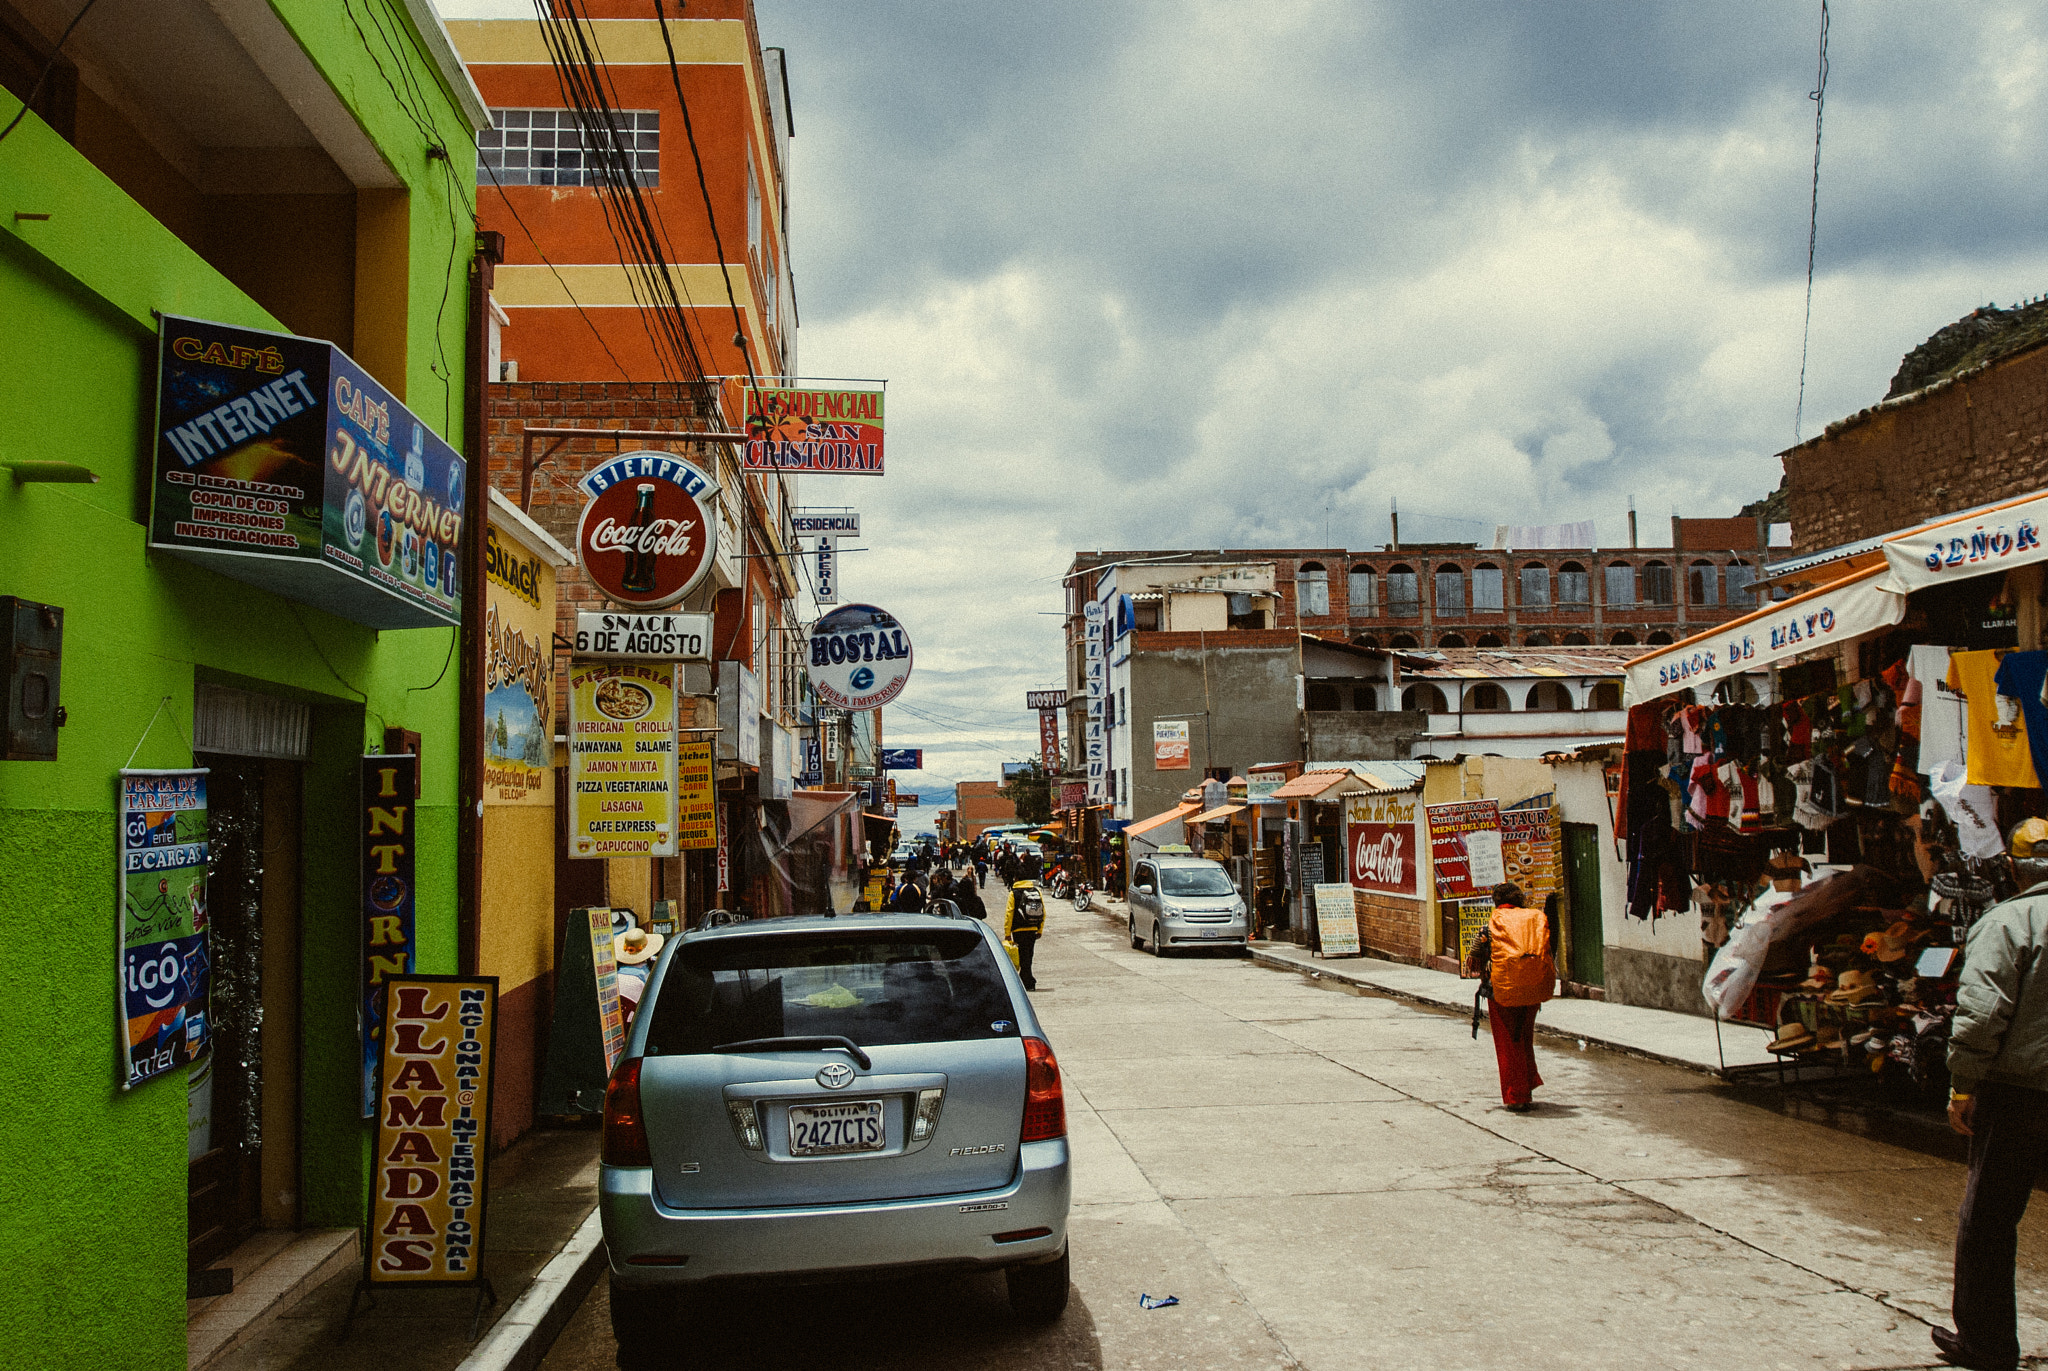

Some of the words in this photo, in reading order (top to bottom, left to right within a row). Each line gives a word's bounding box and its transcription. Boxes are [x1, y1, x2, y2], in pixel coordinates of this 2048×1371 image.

[173, 337, 284, 375] CAFÉ
[335, 376, 390, 445] CAFÉ
[746, 390, 883, 420] RESIDENCIAL
[165, 370, 317, 466] INTERNET
[806, 424, 862, 440] SAN
[745, 440, 884, 471] CRISTOBAL
[166, 471, 195, 486] SE
[198, 474, 304, 499] REALIZAN:
[594, 458, 702, 495] SIEMPRE
[190, 490, 235, 508] COPIA
[235, 494, 255, 511] DE
[192, 507, 285, 531] IMPRESIONES
[793, 517, 858, 530] RESIDENCIAL
[175, 522, 299, 550] INVESTIGACIONES.
[486, 525, 541, 606] SNACK
[818, 537, 832, 595] IMPERIO
[602, 615, 678, 632] SNACK
[1729, 635, 1755, 664] DE
[1770, 607, 1836, 651] MAYO
[576, 631, 589, 651] 6
[594, 632, 620, 652] DE
[625, 632, 701, 655] AGOSTO
[809, 630, 909, 666] HOSTAL
[572, 666, 672, 690] PIZZERIA
[1088, 624, 1104, 714] PLAYA
[818, 680, 849, 706] VILLA
[852, 675, 905, 706] IMPERIAL
[1028, 692, 1066, 707] HOSTAL
[634, 721, 673, 733] CRIOLLA
[573, 741, 623, 753] HAWAYANA
[635, 741, 672, 752] SALAME
[586, 761, 618, 773] JAMON
[620, 761, 627, 772] Y
[629, 761, 658, 772] MIXTA
[1088, 724, 1105, 796] AZUL
[126, 777, 175, 792] VENTA
[178, 777, 197, 791] DE
[576, 781, 603, 793] PIZZA
[605, 781, 669, 792] VEGETARIANA
[126, 793, 197, 809] TARJETAS
[601, 801, 644, 812] LASAGNA
[1429, 803, 1495, 814] RESTAURANT
[589, 821, 613, 832] CAFE
[615, 820, 656, 832] EXPRESS
[1432, 825, 1459, 834] MENU
[1461, 823, 1479, 831] DEL
[1480, 821, 1497, 829] DIA
[126, 846, 202, 870] ECARGAS
[596, 840, 649, 852] CAPUCCINO
[718, 803, 728, 890] FARMACIA
[1434, 856, 1468, 864] SEGUNDO
[1436, 875, 1466, 884] POSTRE
[813, 1107, 859, 1118] BOLIVIA
[377, 987, 449, 1274] LLAMADAS
[796, 1117, 878, 1149] 2427CTS
[950, 1144, 1005, 1157] FIELDER
